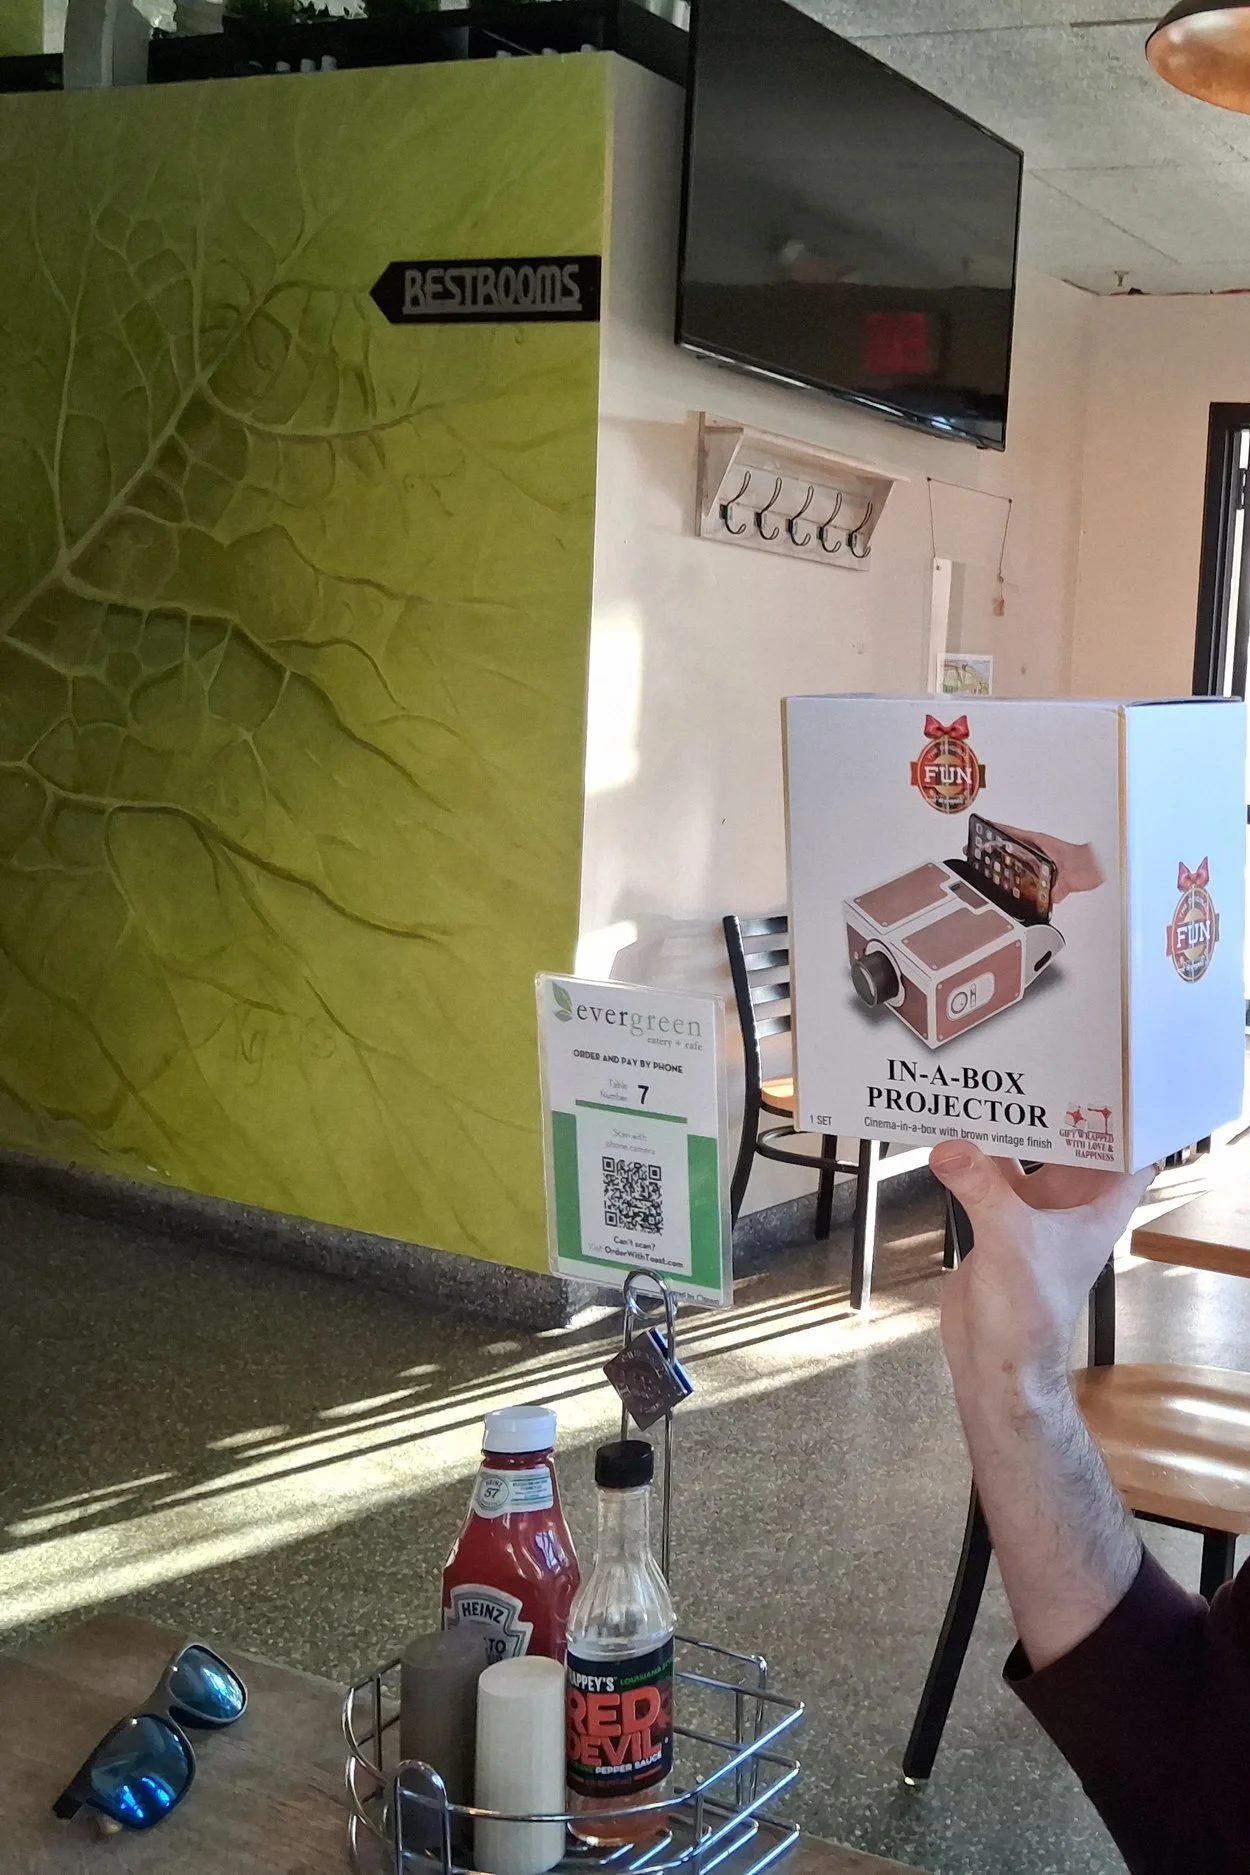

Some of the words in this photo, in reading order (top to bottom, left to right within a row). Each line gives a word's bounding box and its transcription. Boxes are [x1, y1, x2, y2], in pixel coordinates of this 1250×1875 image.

[403, 263, 581, 311] RESTROOMS
[924, 766, 972, 784] FUN
[1176, 920, 1210, 948] FUN
[576, 1003, 702, 1037] evergreen
[647, 1036, 672, 1048] eatery
[573, 1048, 600, 1061] ORDER
[602, 1054, 620, 1064] AND
[621, 1057, 638, 1067] PAY
[640, 1060, 651, 1069] BY
[653, 1062, 683, 1074] PHONE
[887, 1058, 1026, 1096] IN-A-BOX
[638, 1084, 649, 1105] 7
[866, 1085, 1050, 1129] PROJECTOR
[810, 1115, 814, 1124] 1
[816, 1115, 832, 1126] SET
[612, 1128, 630, 1139] Scan
[632, 1132, 647, 1141] with
[864, 1116, 936, 1135] Cinema-in-a-box
[939, 1125, 958, 1138] with
[961, 1128, 989, 1142] brown
[991, 1132, 1025, 1148] vintage
[1027, 1136, 1052, 1150] finish
[1059, 1128, 1076, 1138] GIFT
[1077, 1129, 1114, 1144] WRAPPED
[1065, 1138, 1085, 1149] WITH
[1088, 1141, 1105, 1152] LOVE
[1107, 1144, 1114, 1153] &
[1075, 1149, 1114, 1162] HAPPINESS
[613, 1235, 633, 1246] Can't
[634, 1241, 656, 1251] scan?
[604, 1246, 684, 1269] OrderWithToast.com
[484, 1487, 500, 1499] 57
[485, 1479, 503, 1488] HEINZ
[461, 1601, 504, 1624] HEINZ
[566, 1685, 661, 1738] RED
[566, 1727, 662, 1767] DEVIL
[595, 1763, 632, 1775] PEPPER
[634, 1750, 662, 1770] SAUCE
